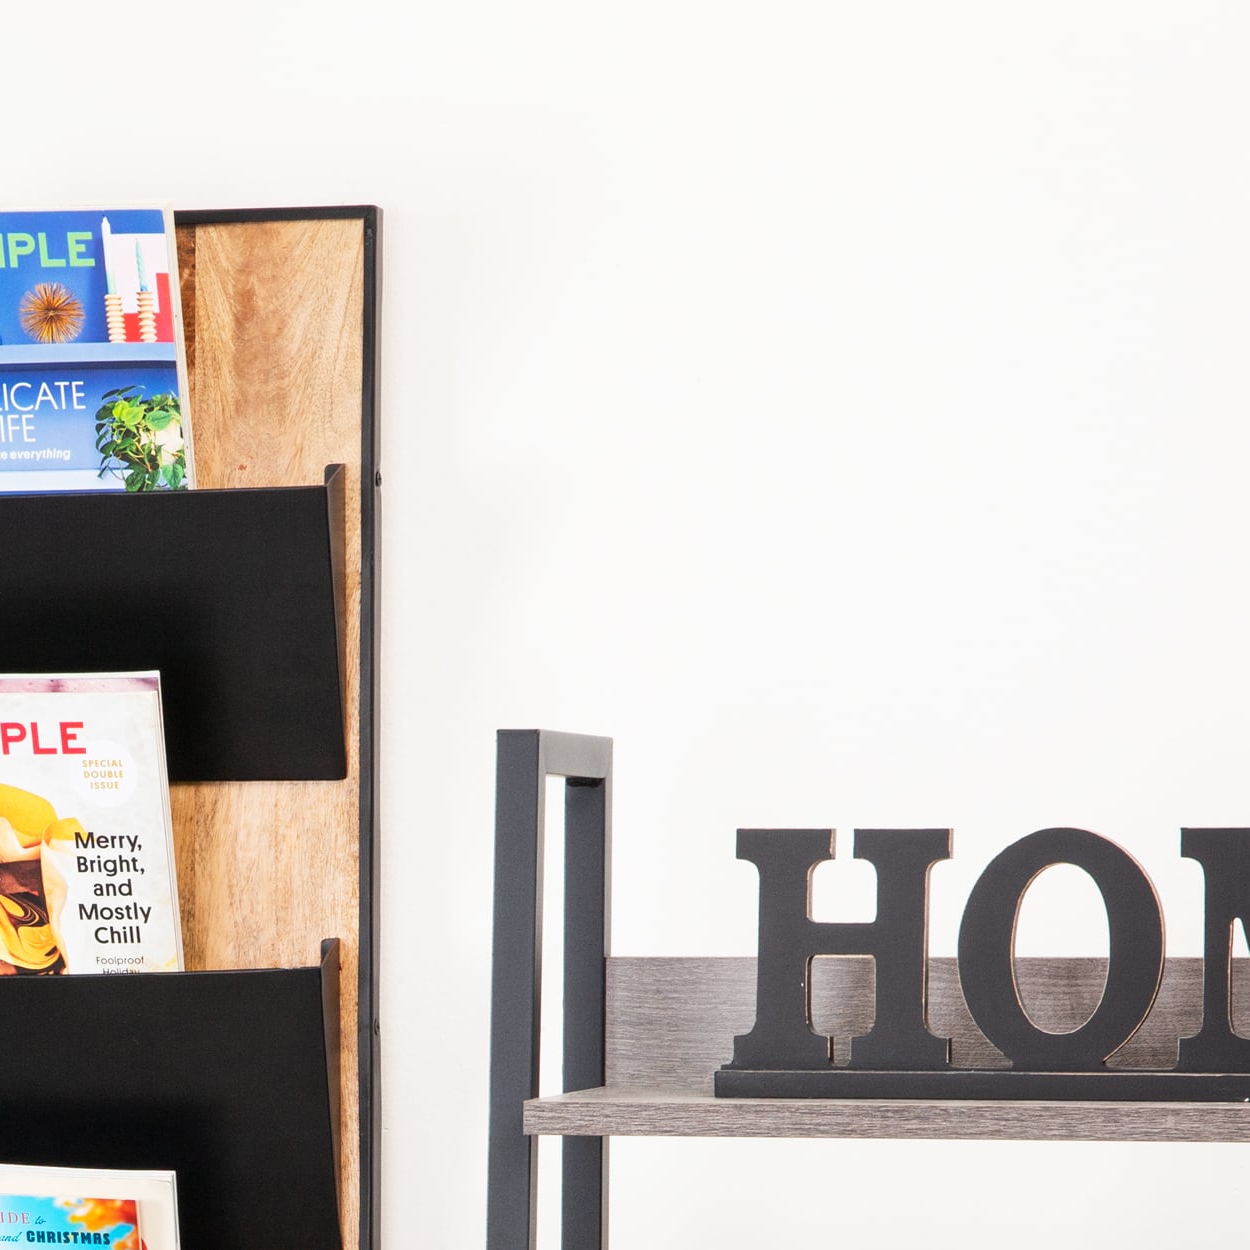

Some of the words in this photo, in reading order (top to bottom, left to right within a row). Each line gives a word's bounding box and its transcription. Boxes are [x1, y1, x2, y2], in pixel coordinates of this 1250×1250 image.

[9, 447, 71, 461] everything
[82, 759, 124, 768] SPECIAL
[83, 770, 124, 779] DOUBLE
[90, 781, 119, 790] ISSUE
[74, 831, 143, 853] Merry,
[76, 854, 145, 877] Bright,
[93, 878, 133, 897] and
[78, 902, 152, 924] Mostly
[94, 925, 141, 944] Chill
[95, 955, 144, 966] Foolproof
[34, 1215, 47, 1225] to
[25, 1229, 111, 1246] CHRISTMAS
